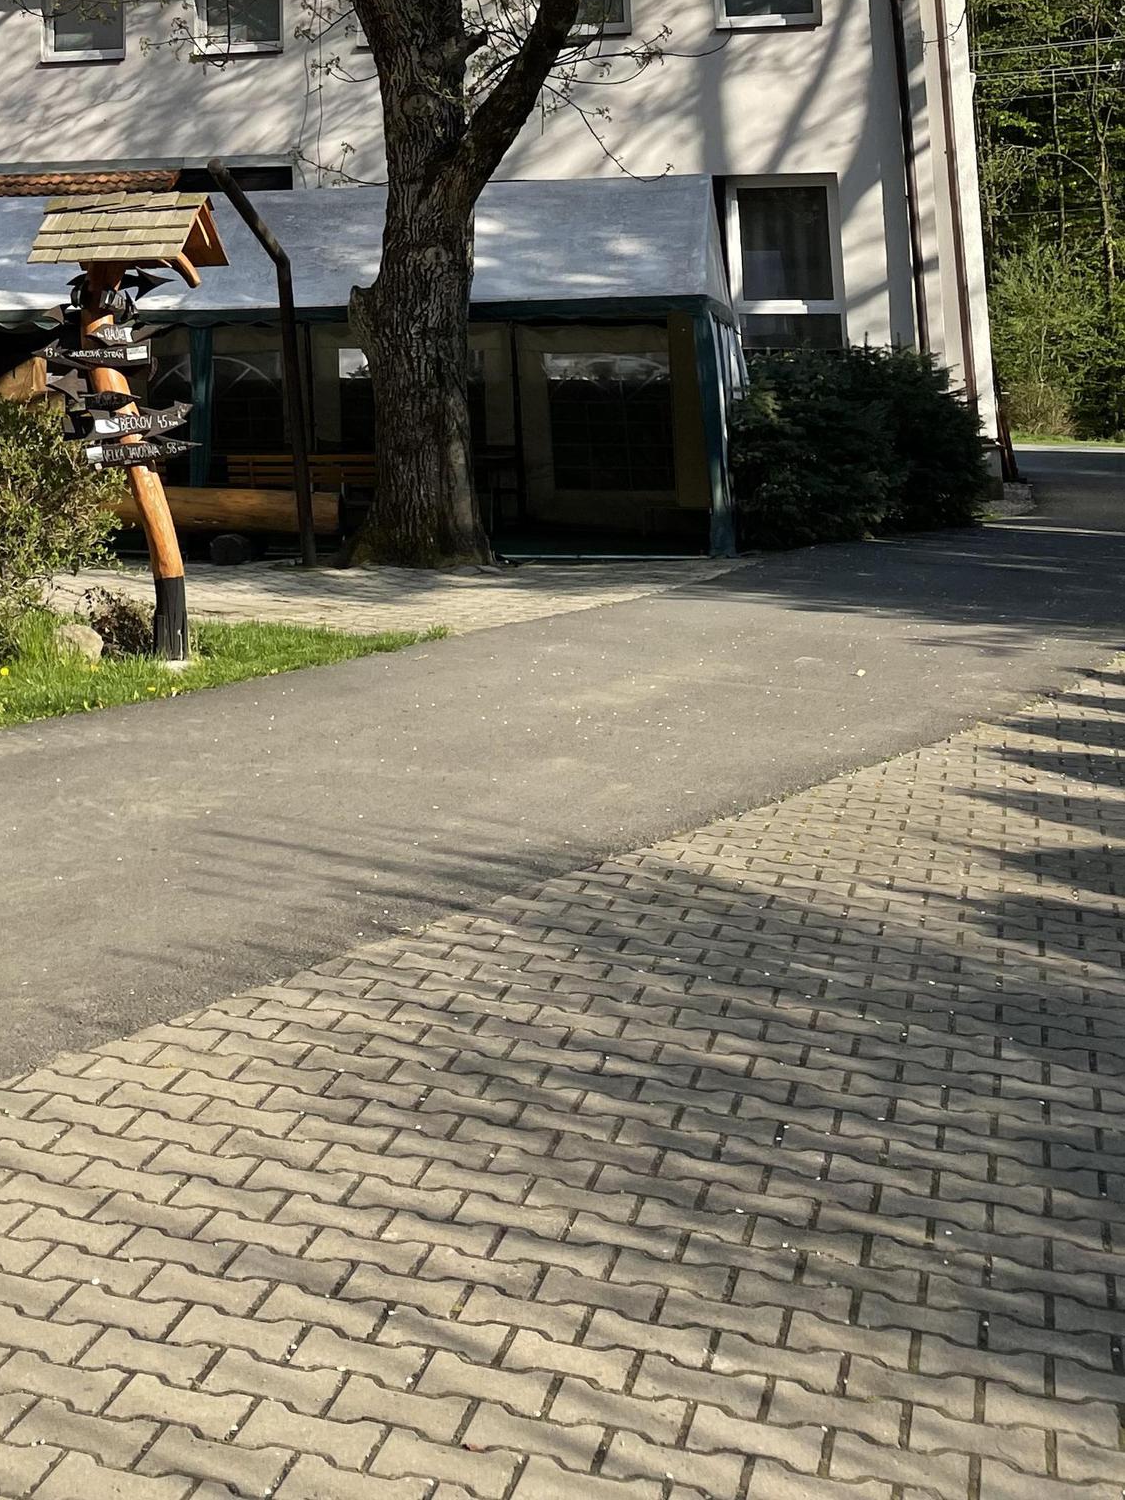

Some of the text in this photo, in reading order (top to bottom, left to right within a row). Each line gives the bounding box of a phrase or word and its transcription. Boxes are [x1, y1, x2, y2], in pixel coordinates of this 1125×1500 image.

[119, 415, 153, 431] BECKOV
[157, 414, 168, 429] 45
[165, 441, 177, 454] 58
